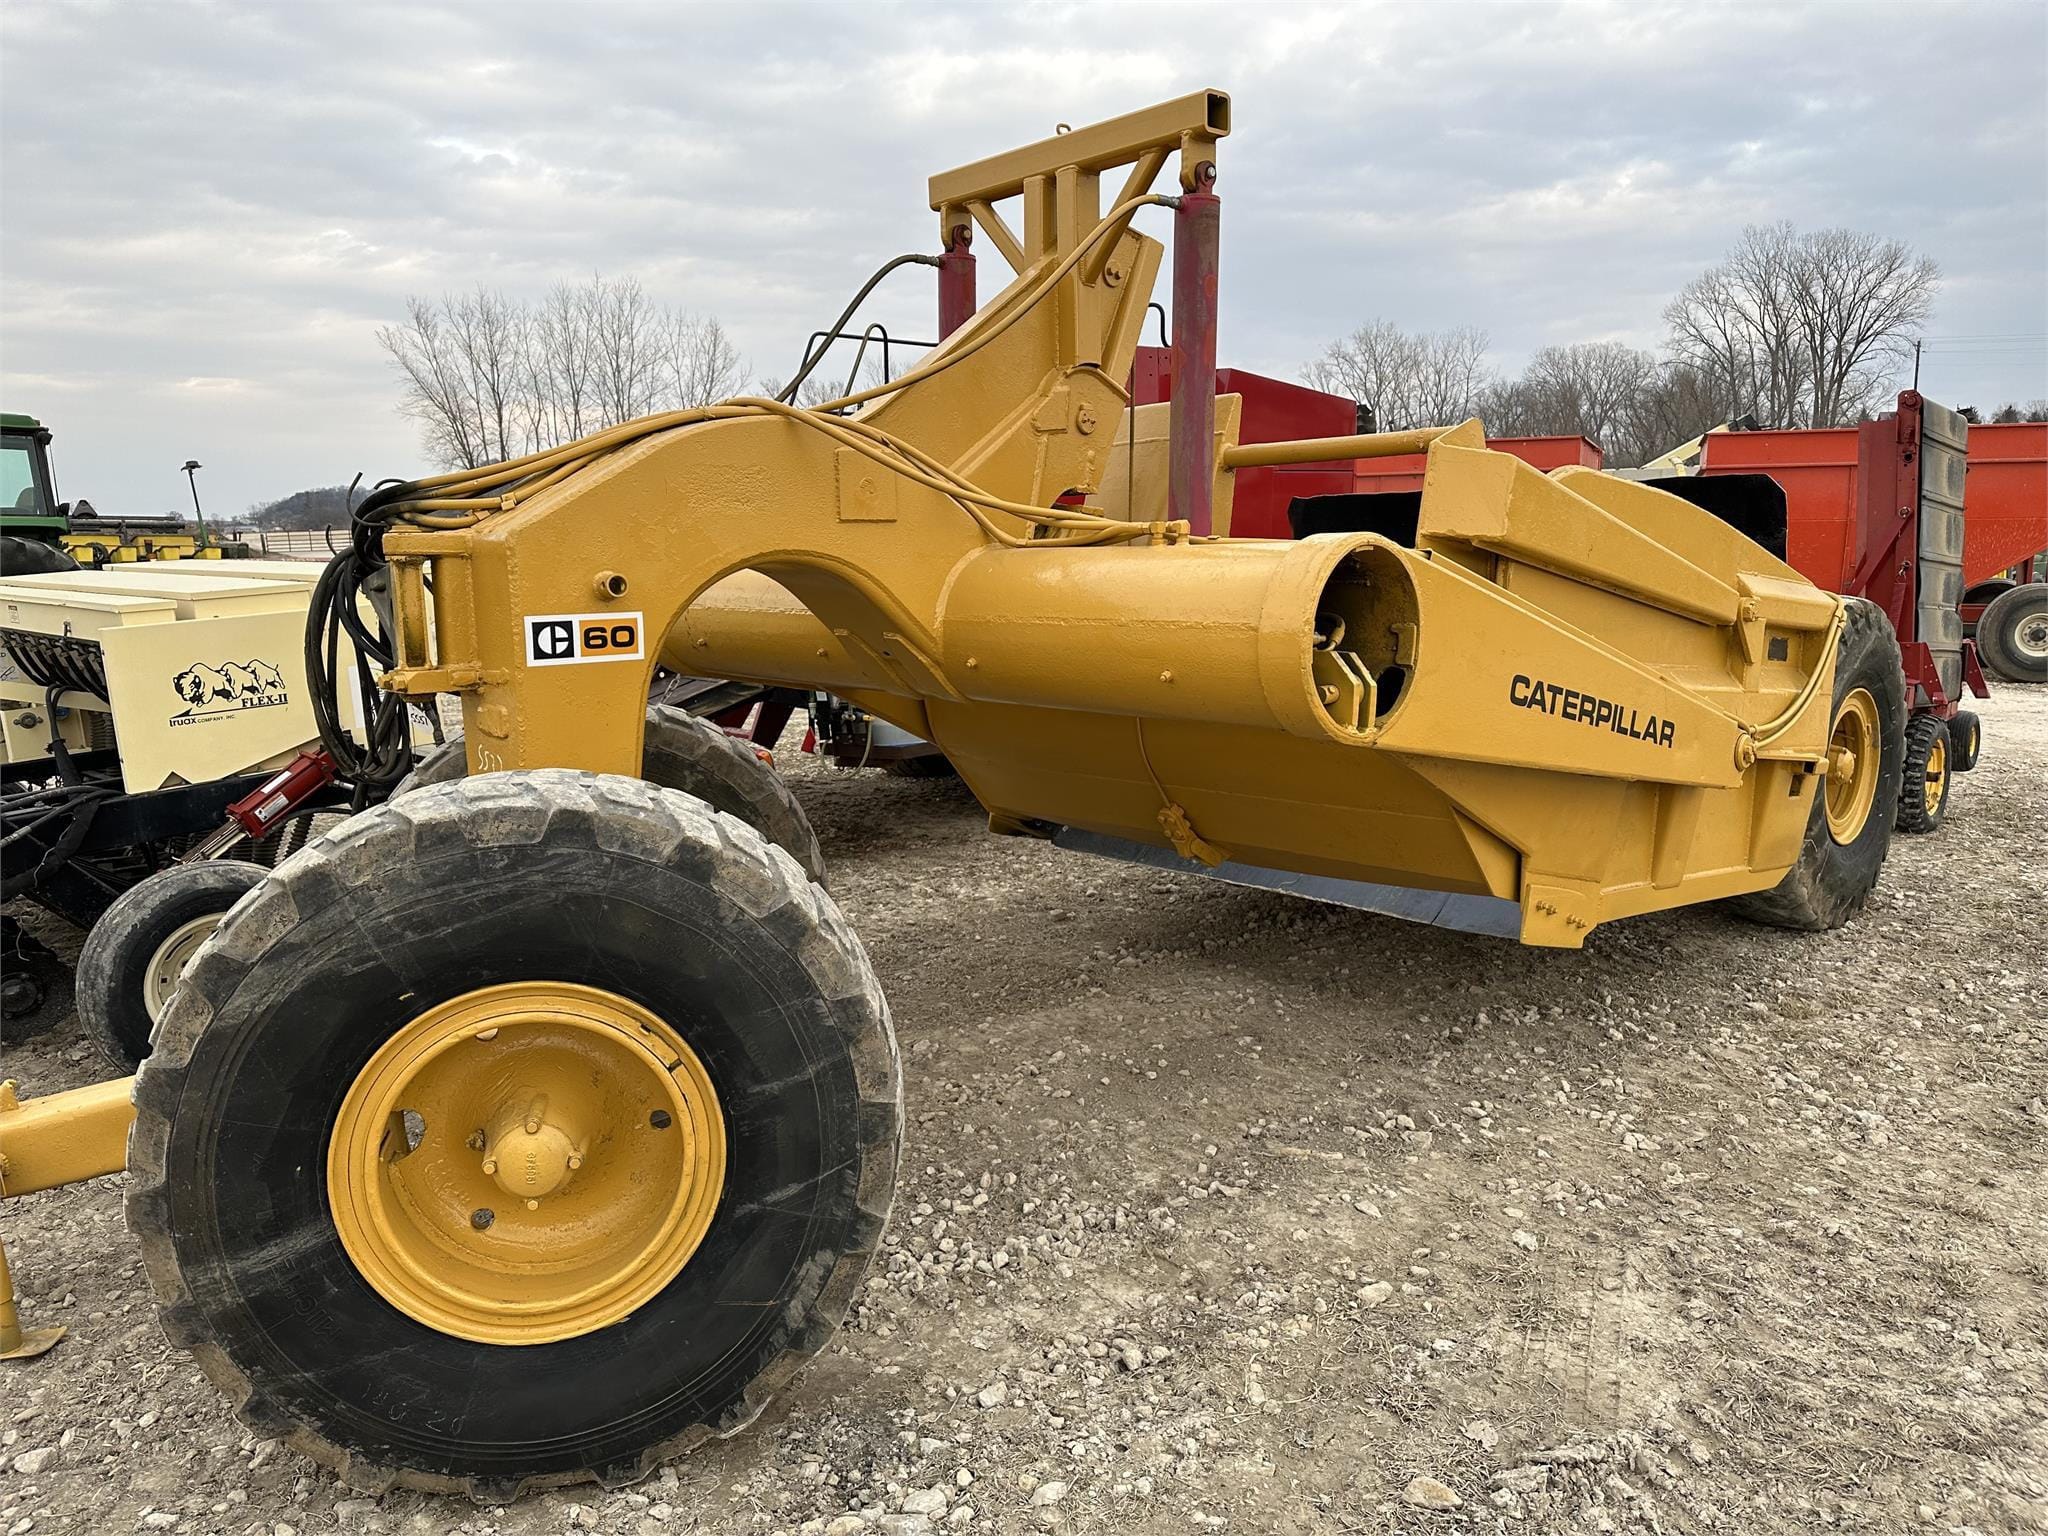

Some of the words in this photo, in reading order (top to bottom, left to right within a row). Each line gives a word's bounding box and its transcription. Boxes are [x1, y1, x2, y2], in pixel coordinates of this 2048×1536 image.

[583, 625, 635, 650] 60
[241, 693, 289, 708] FLEX-II
[1510, 674, 1675, 748] CATERPILLAR
